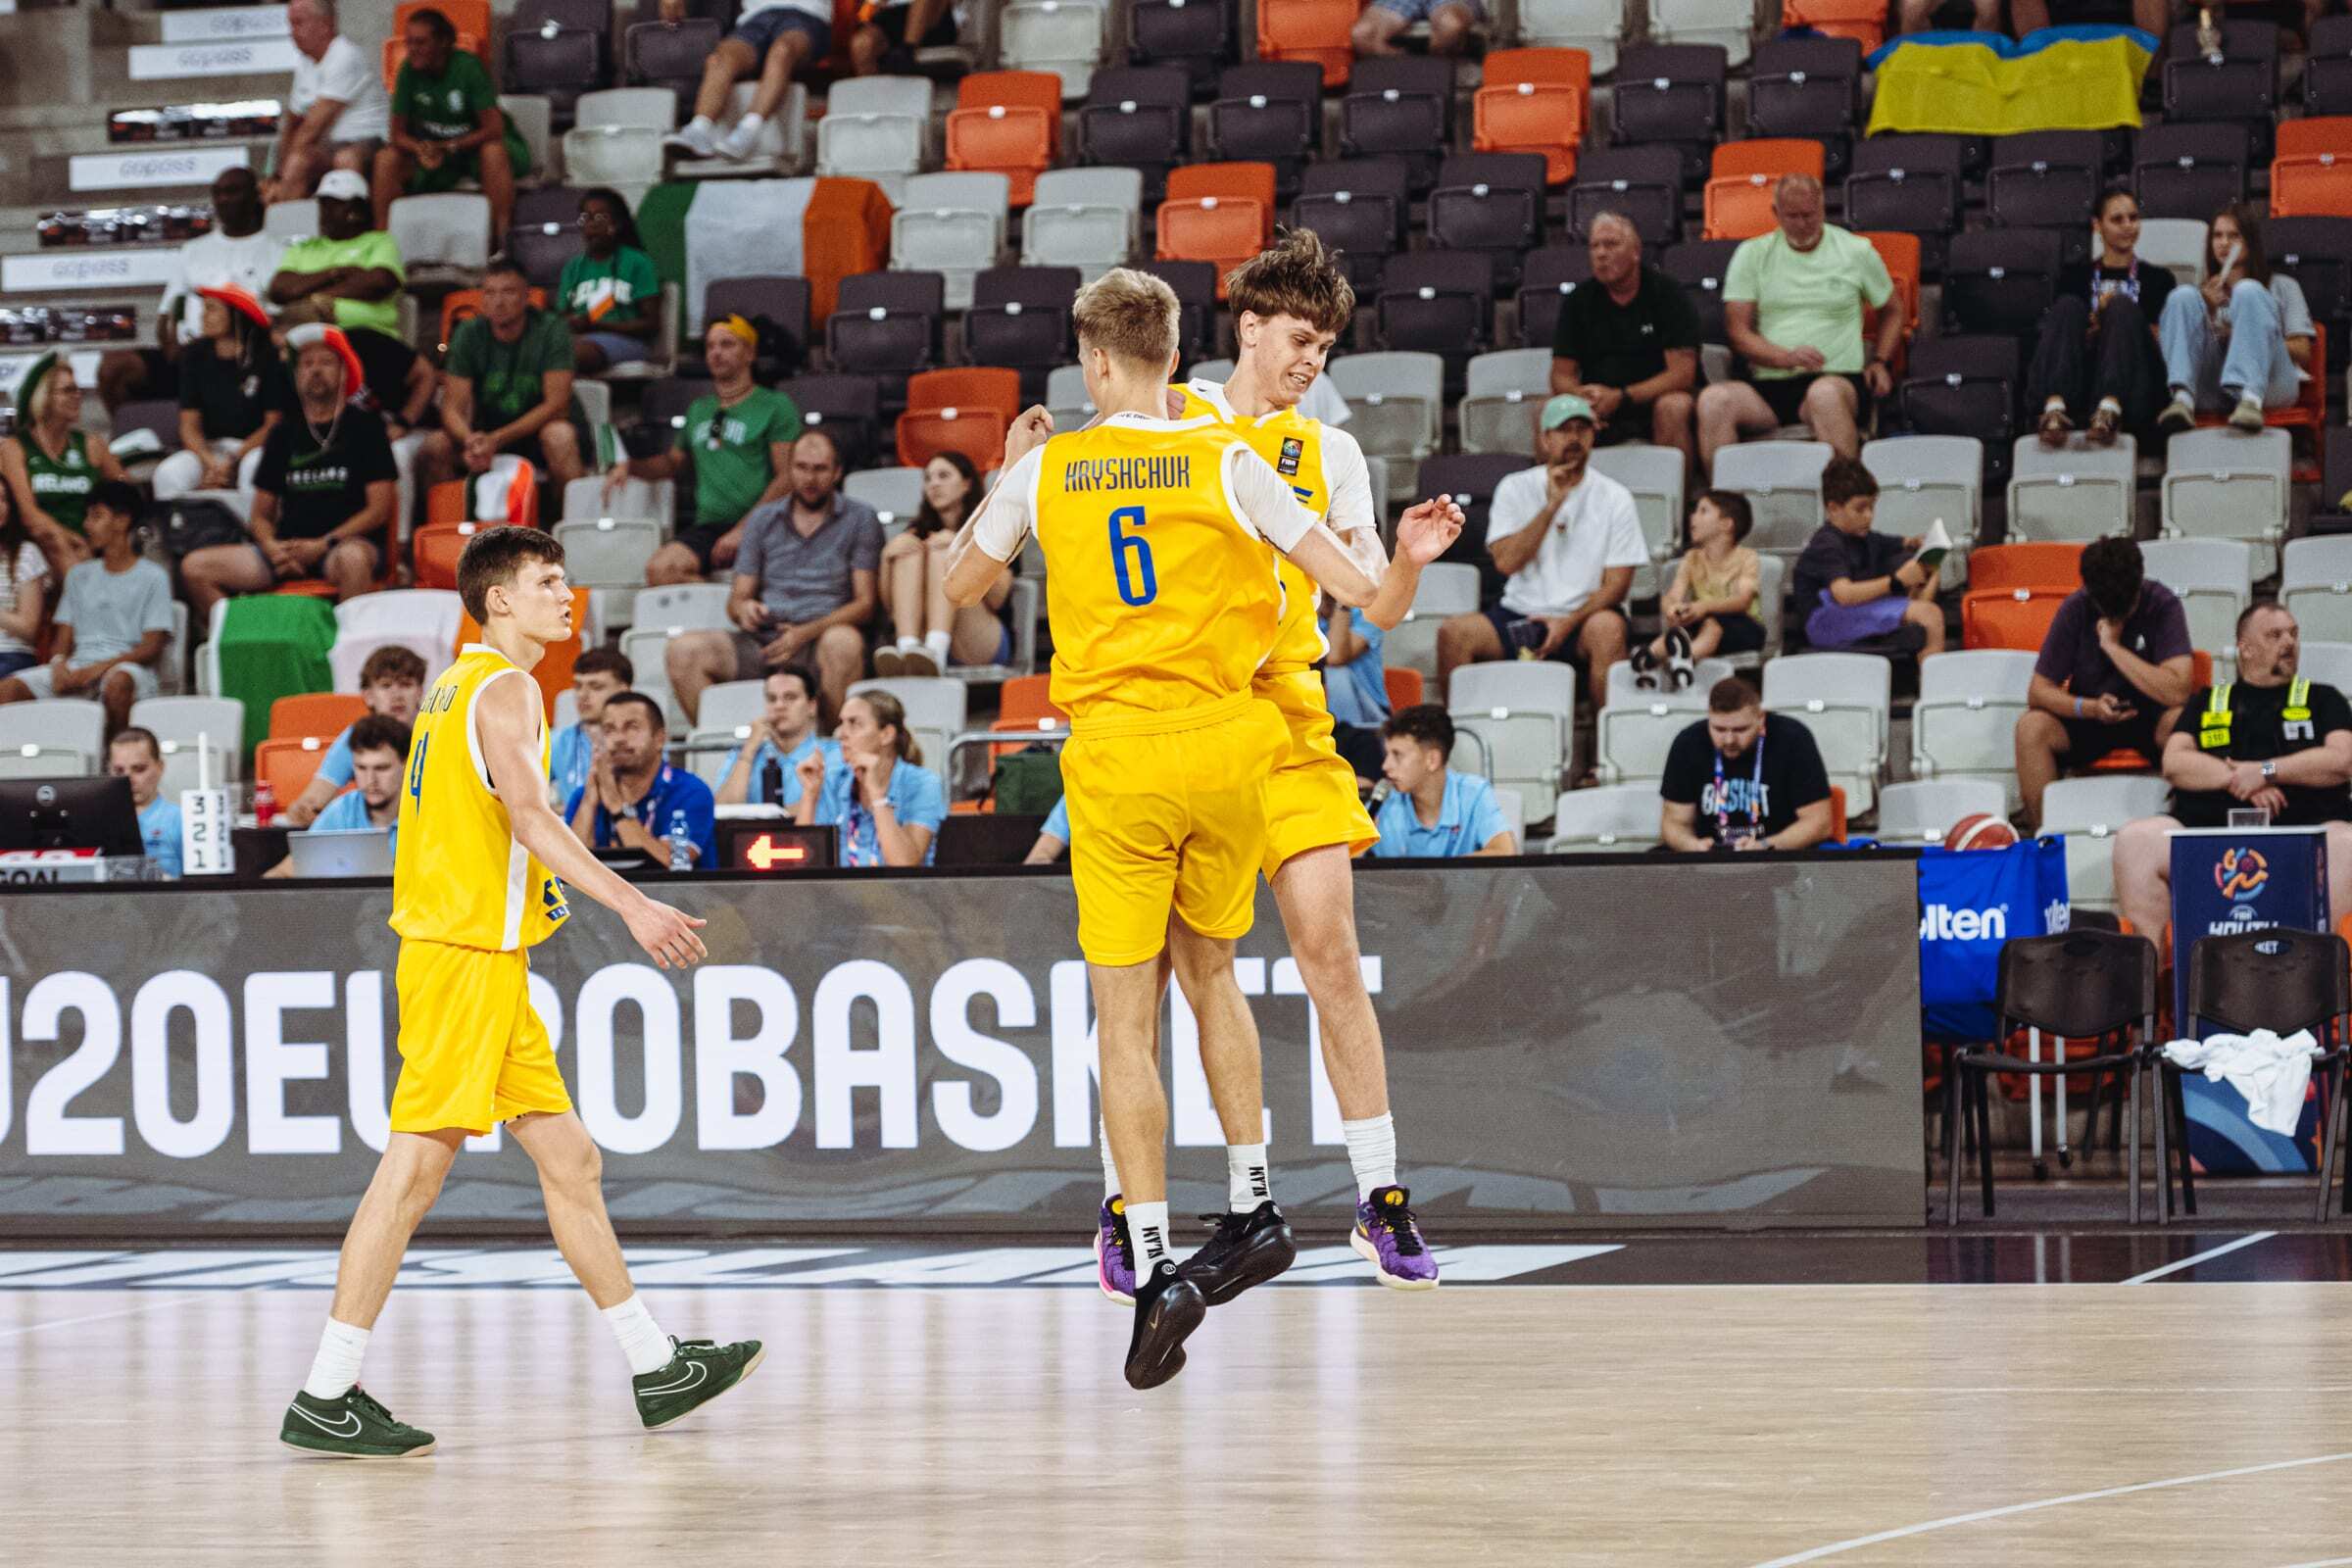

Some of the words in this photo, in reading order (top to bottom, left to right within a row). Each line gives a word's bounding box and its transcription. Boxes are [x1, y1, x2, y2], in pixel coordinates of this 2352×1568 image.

[1064, 456, 1191, 492] HRYSHCHUK
[1107, 505, 1157, 607] 6
[411, 731, 429, 816] 4
[192, 795, 205, 814] 3
[1701, 778, 1770, 817] BSKT
[193, 822, 207, 842] 2
[194, 849, 207, 868] 1
[1920, 904, 2006, 941] lten
